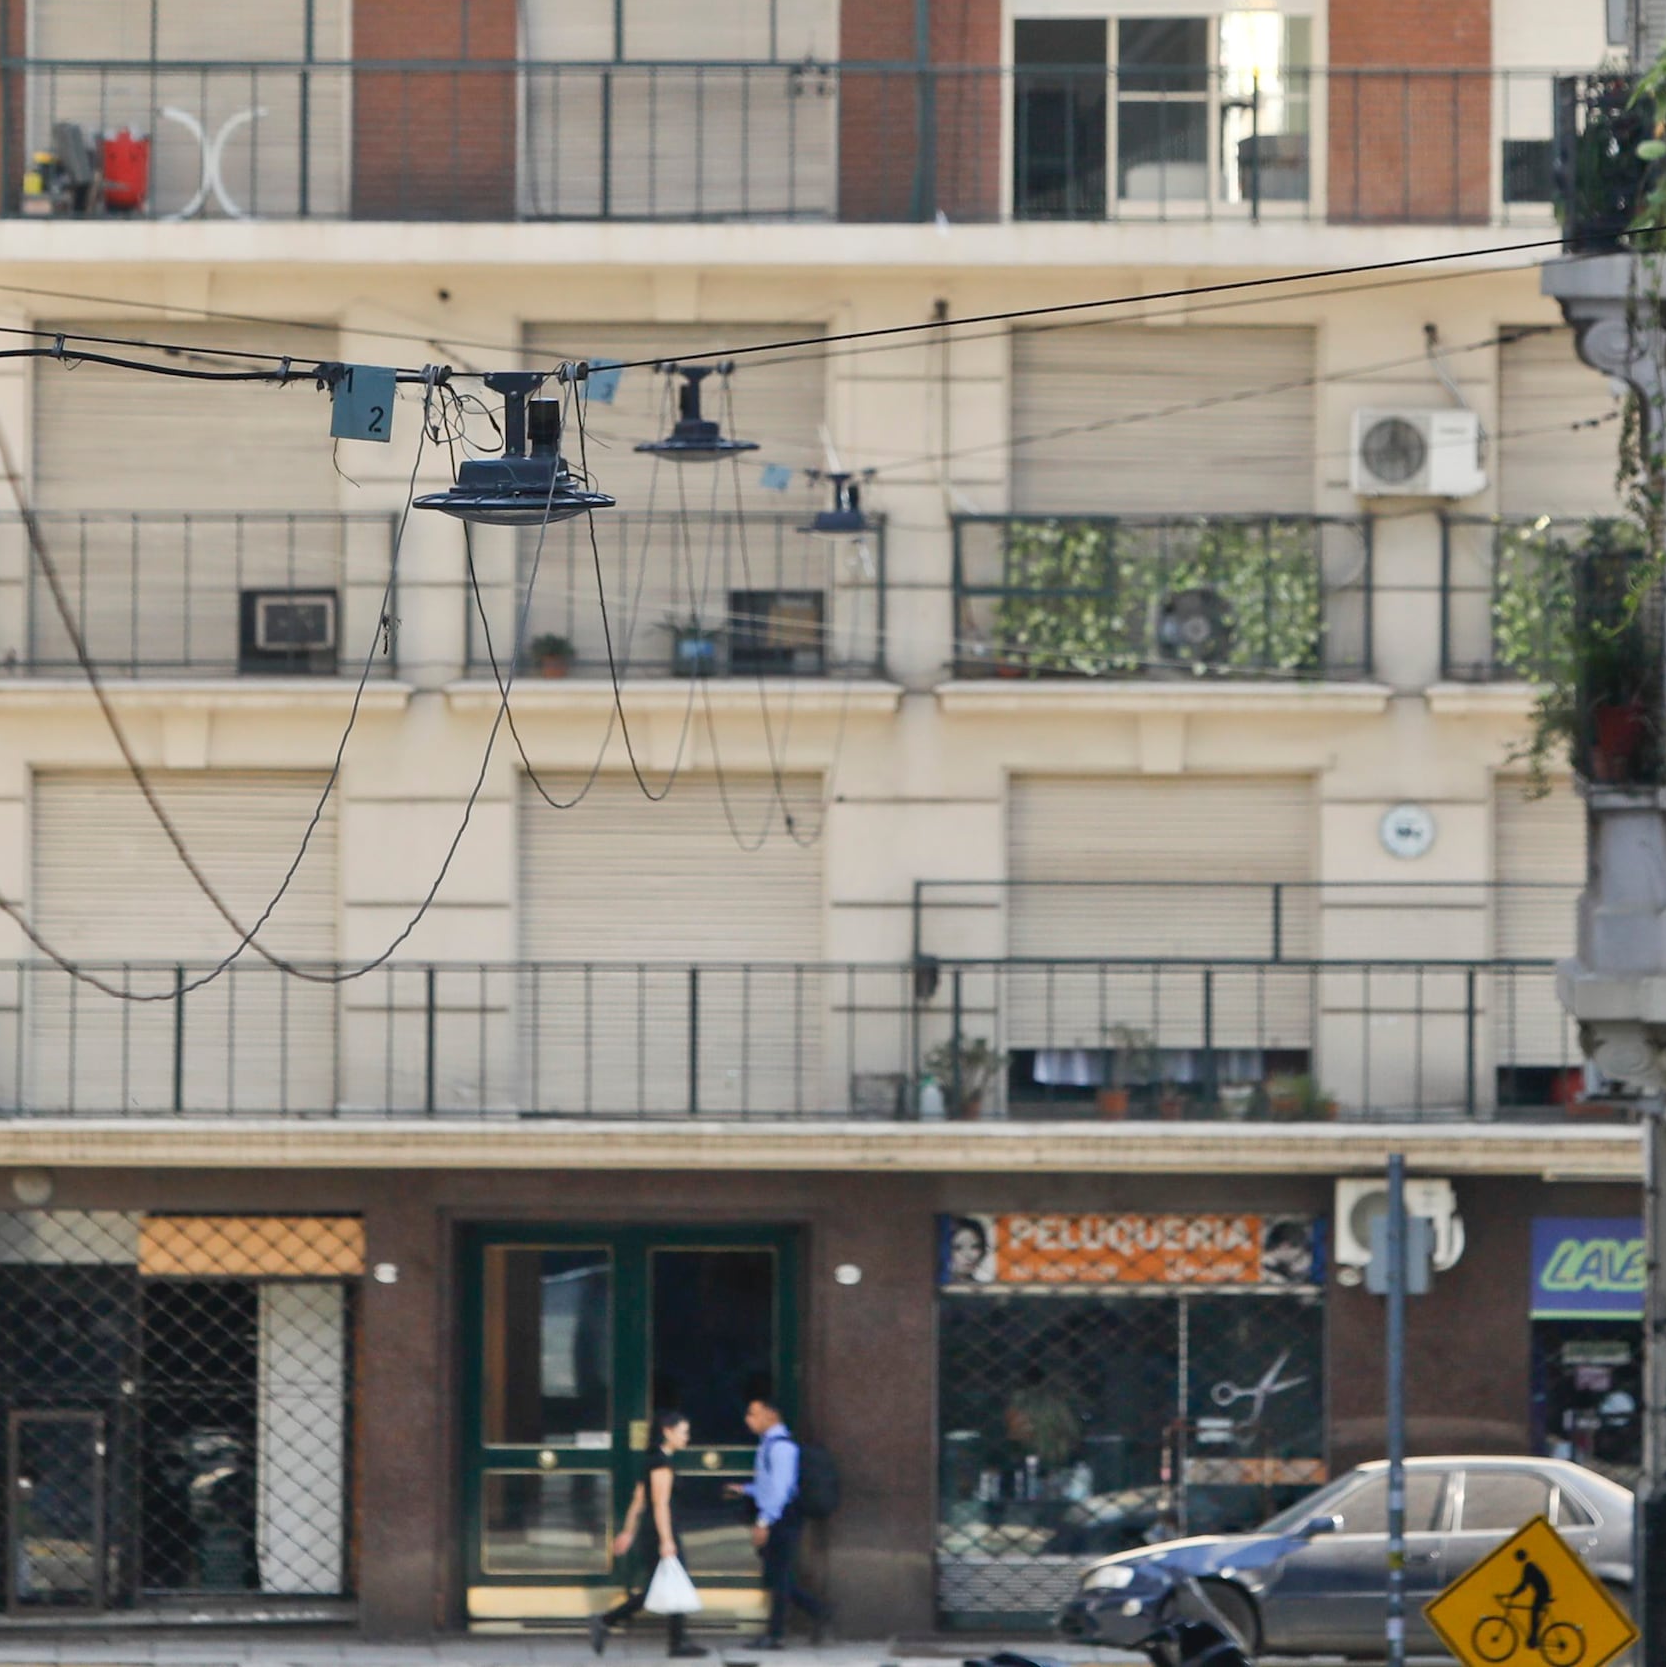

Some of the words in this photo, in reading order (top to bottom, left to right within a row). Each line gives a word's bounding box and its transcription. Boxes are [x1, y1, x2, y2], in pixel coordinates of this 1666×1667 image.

[345, 367, 354, 393] 1
[368, 406, 384, 432] 2
[1009, 1220, 1251, 1254] PELUQUERIA
